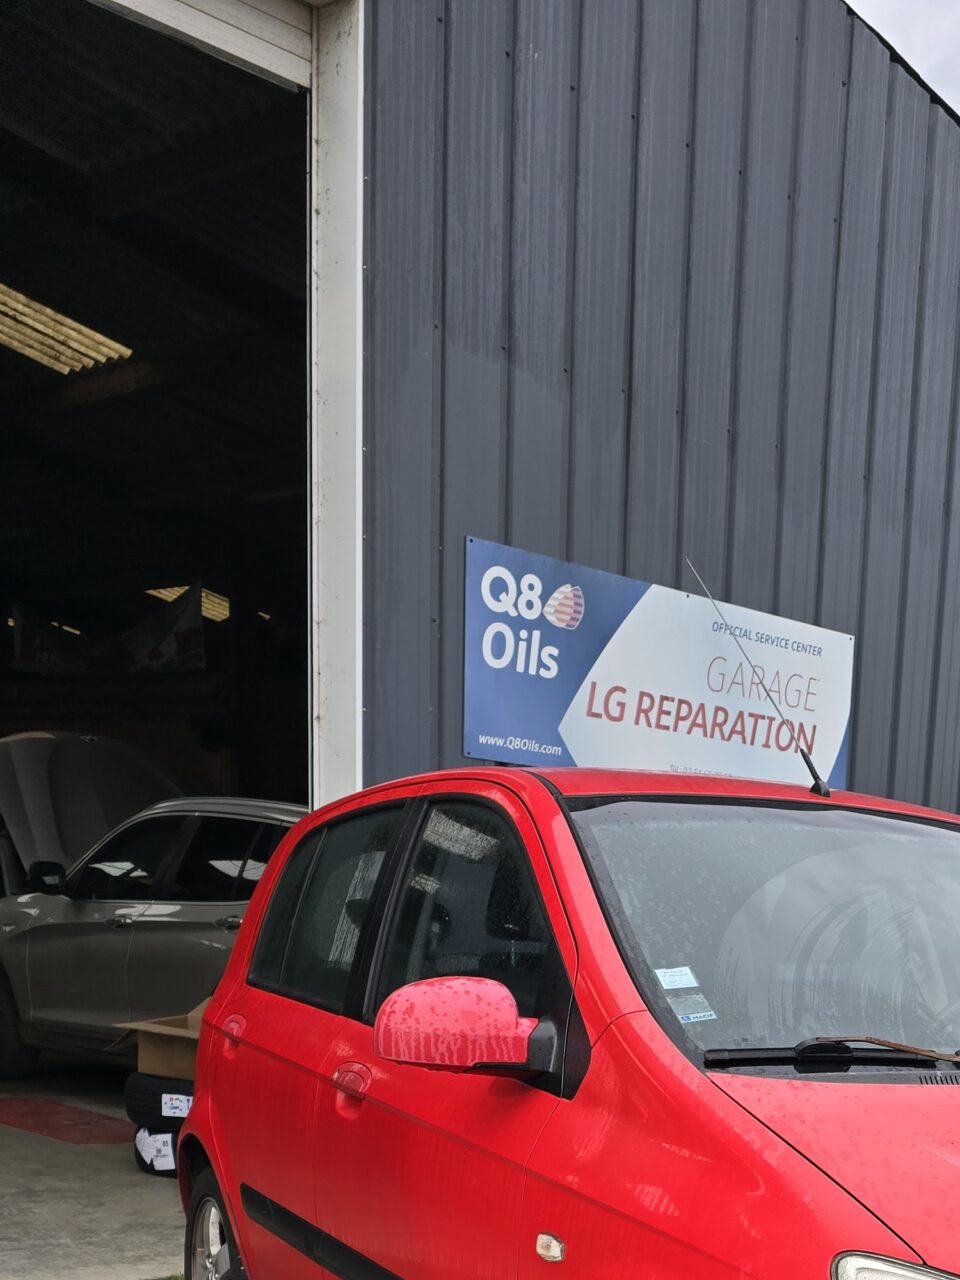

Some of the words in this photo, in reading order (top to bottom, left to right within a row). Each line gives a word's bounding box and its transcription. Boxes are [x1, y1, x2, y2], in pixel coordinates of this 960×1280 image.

[481, 566, 542, 620] Q8
[482, 622, 560, 679] Oils
[712, 621, 753, 641] OFFICIAL
[755, 632, 790, 650] SERVICE
[791, 640, 823, 657] CENTER
[707, 656, 821, 712] GARAGE
[478, 734, 562, 756] www.Q8Oils.com
[586, 681, 627, 723] LG
[634, 690, 817, 756] REPARATION
